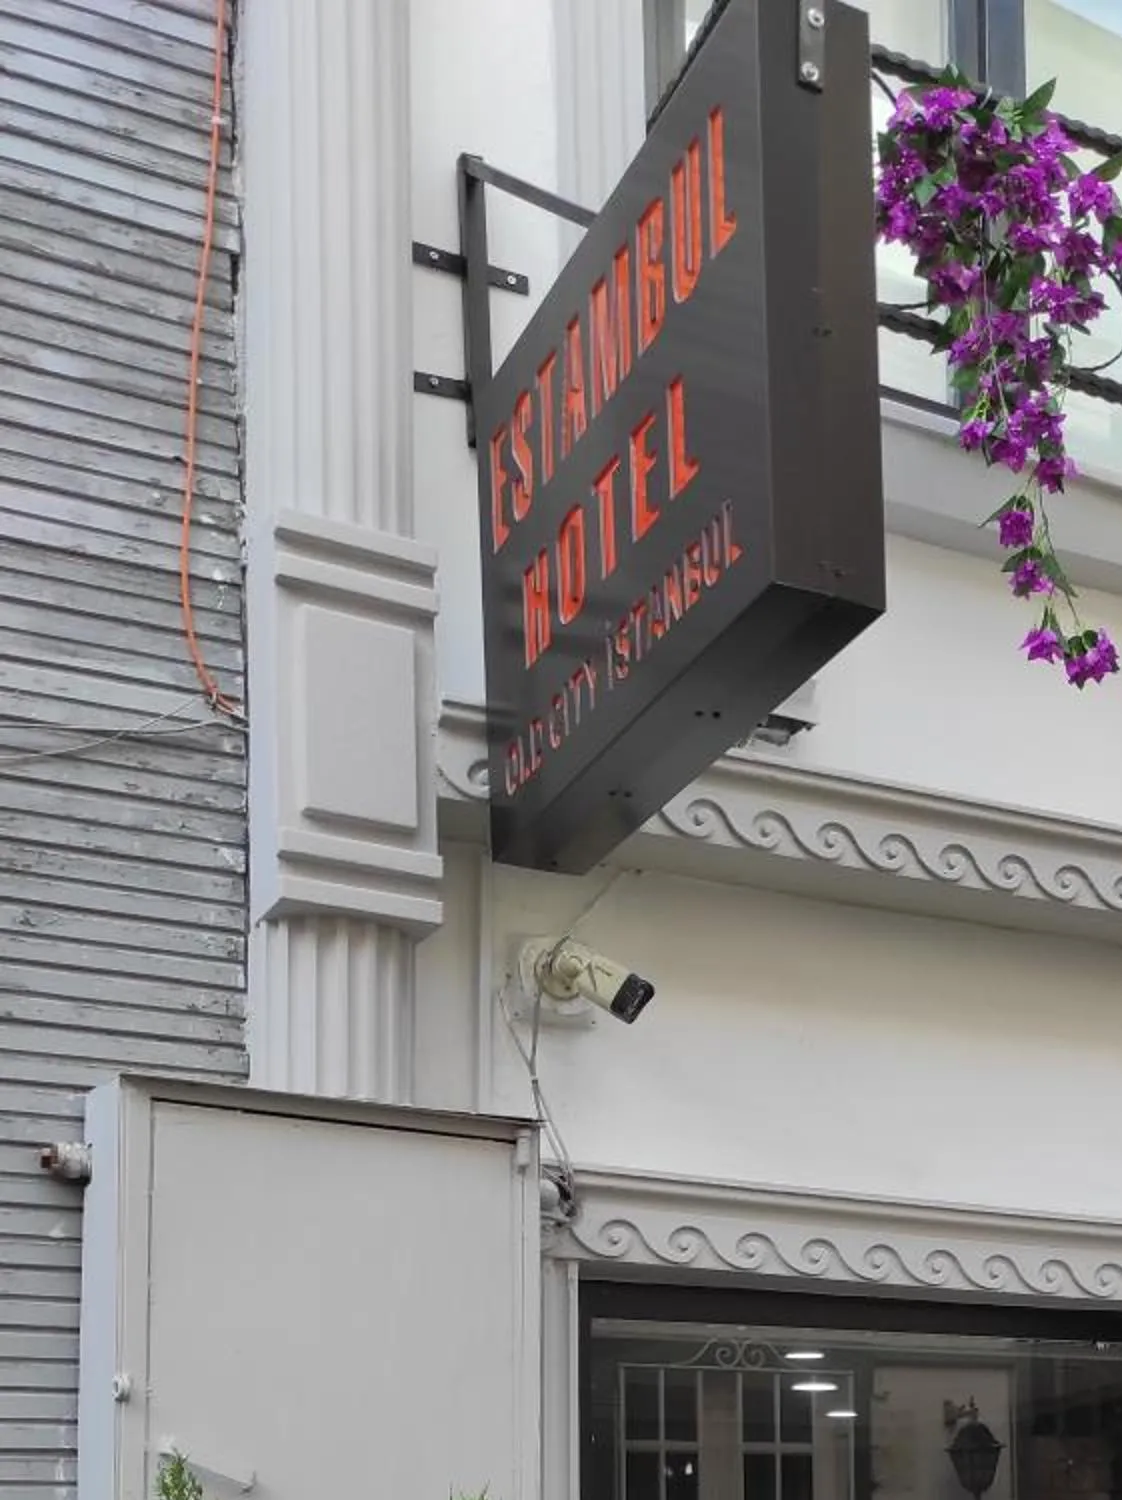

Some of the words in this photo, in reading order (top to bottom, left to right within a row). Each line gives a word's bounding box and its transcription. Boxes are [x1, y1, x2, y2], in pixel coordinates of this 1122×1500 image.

[490, 105, 736, 554] ESTAMBUL
[523, 374, 699, 669] HOTEL
[505, 717, 543, 796] OLD
[549, 659, 597, 749] CITY
